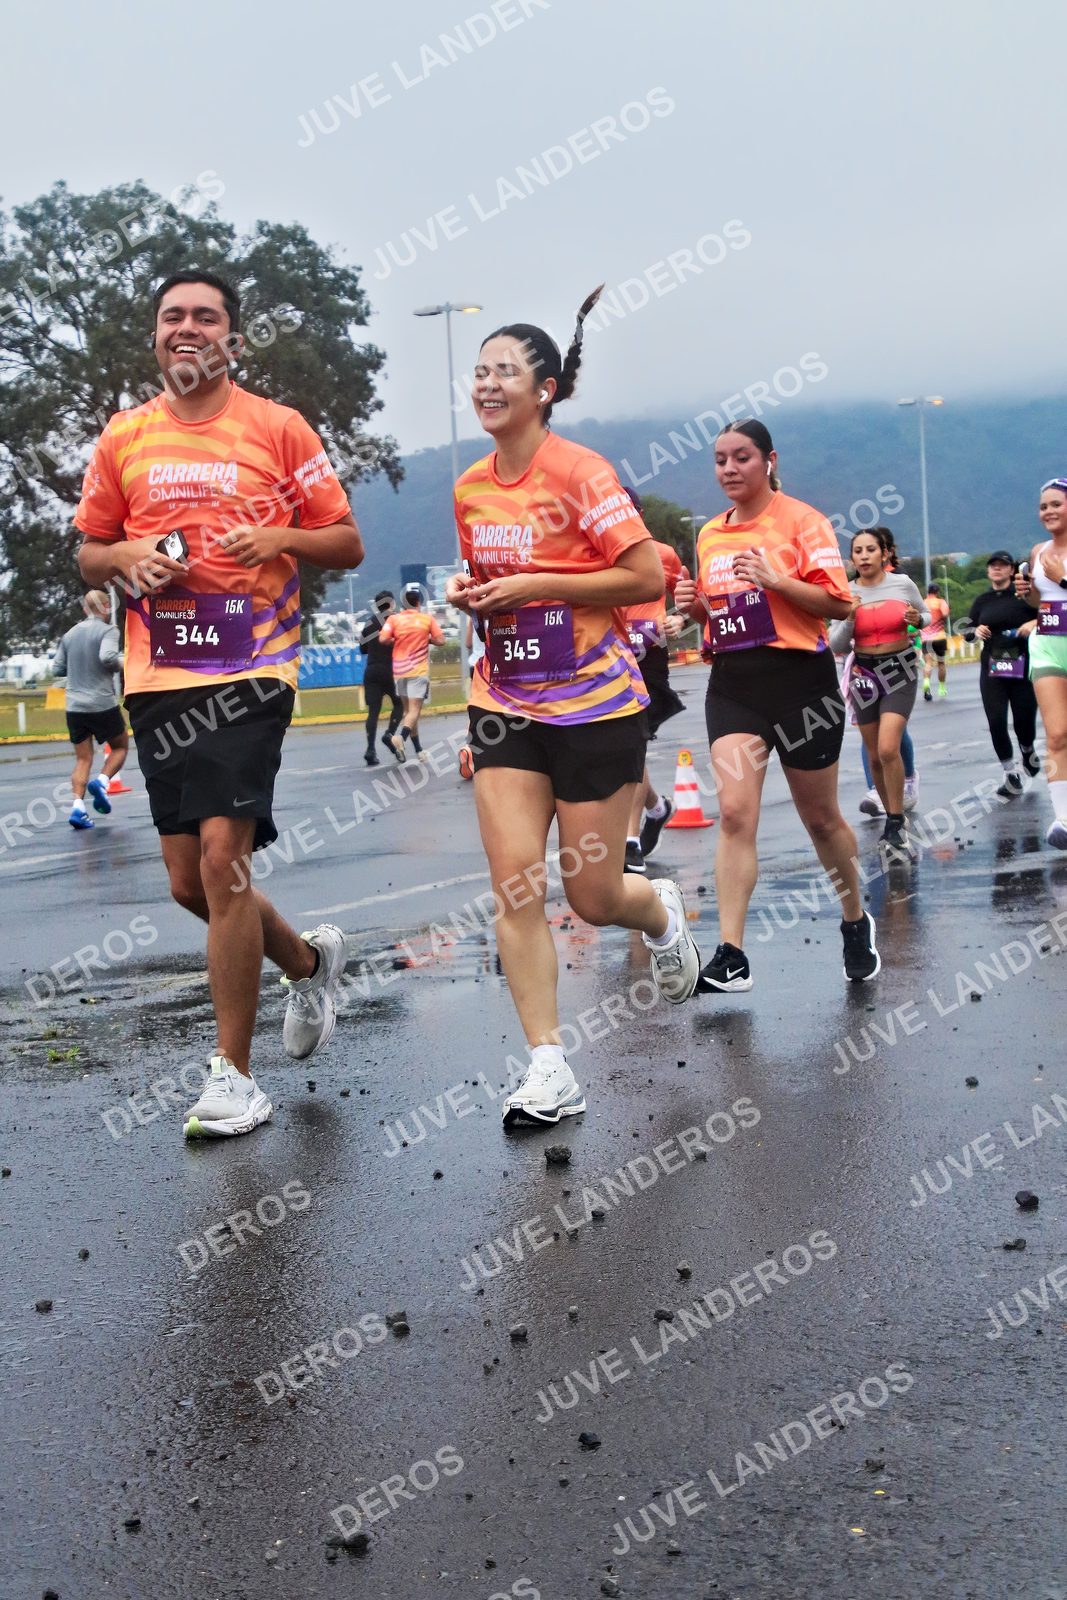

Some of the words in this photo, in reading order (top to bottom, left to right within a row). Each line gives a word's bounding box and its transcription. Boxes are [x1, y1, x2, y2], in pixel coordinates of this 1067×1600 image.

[148, 461, 238, 485] CARRERA
[149, 485, 218, 502] OMNILIFE
[472, 524, 533, 548] CARRERA
[473, 550, 516, 565] OMNILIFE
[155, 599, 196, 611] CARRERA
[744, 591, 761, 606] 15K
[224, 599, 245, 614] 15K
[155, 611, 187, 620] OMNILIFE
[543, 609, 564, 626] 15K
[1042, 614, 1060, 626] 398
[718, 615, 747, 636] 341
[174, 624, 220, 646] 344
[628, 633, 644, 644] 98
[503, 638, 541, 661] 345
[996, 661, 1013, 671] 604
